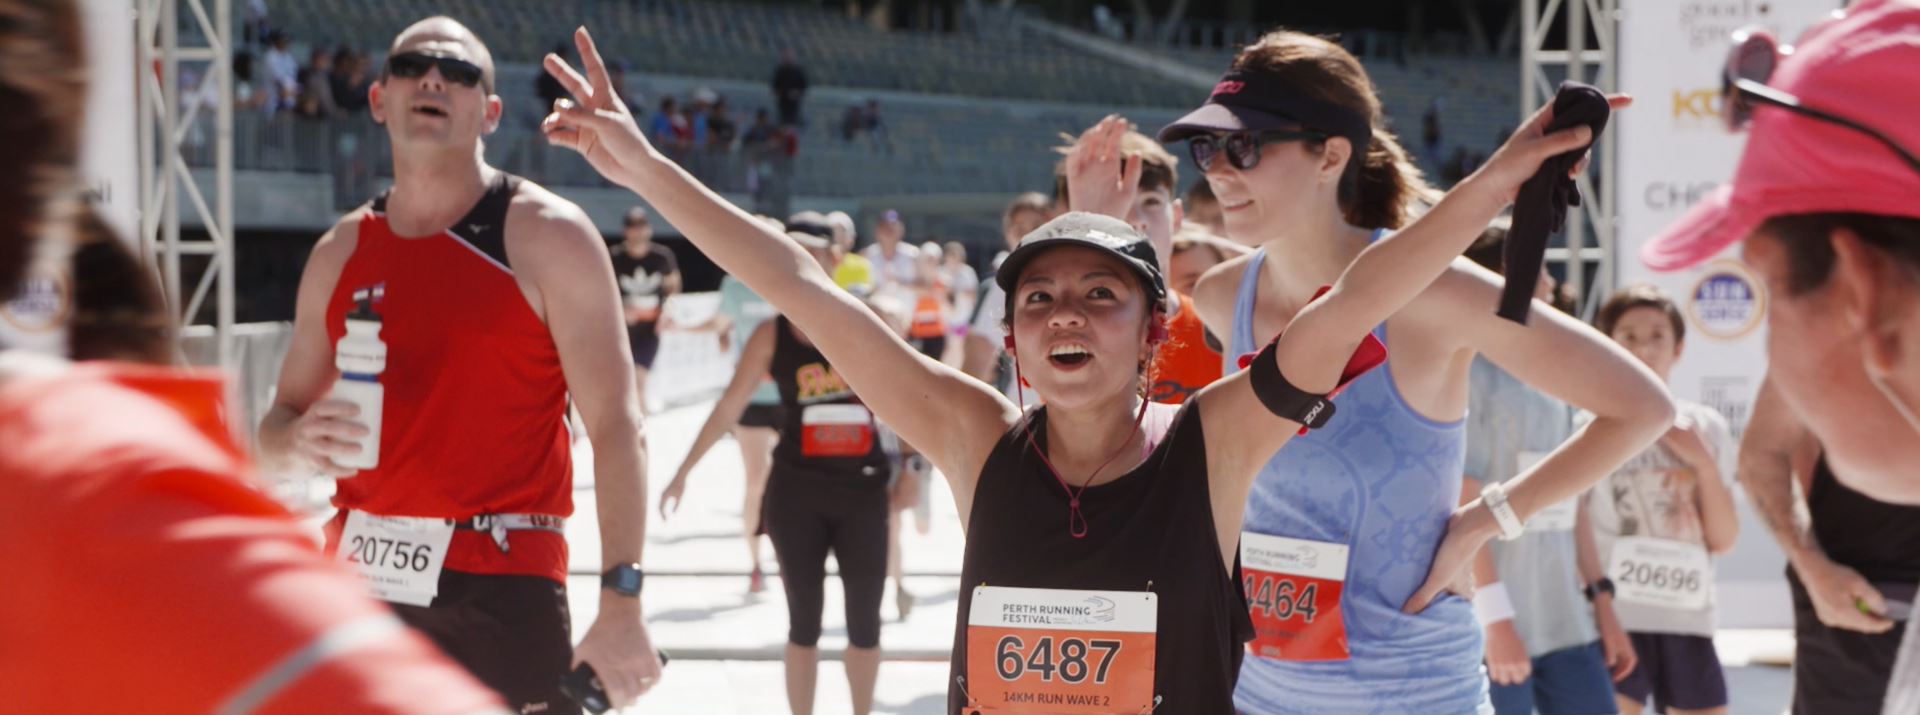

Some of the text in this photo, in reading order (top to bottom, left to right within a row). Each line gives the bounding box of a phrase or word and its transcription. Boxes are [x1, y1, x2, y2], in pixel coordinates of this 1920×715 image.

[347, 535, 433, 573] 20756
[1619, 559, 1700, 592] 20696
[1003, 603, 1091, 616] PERTH RUNNING
[1003, 613, 1052, 624] FESTIVAL
[995, 634, 1123, 685] 6487
[1003, 691, 1110, 707] 14KM RUN WAVE 2
